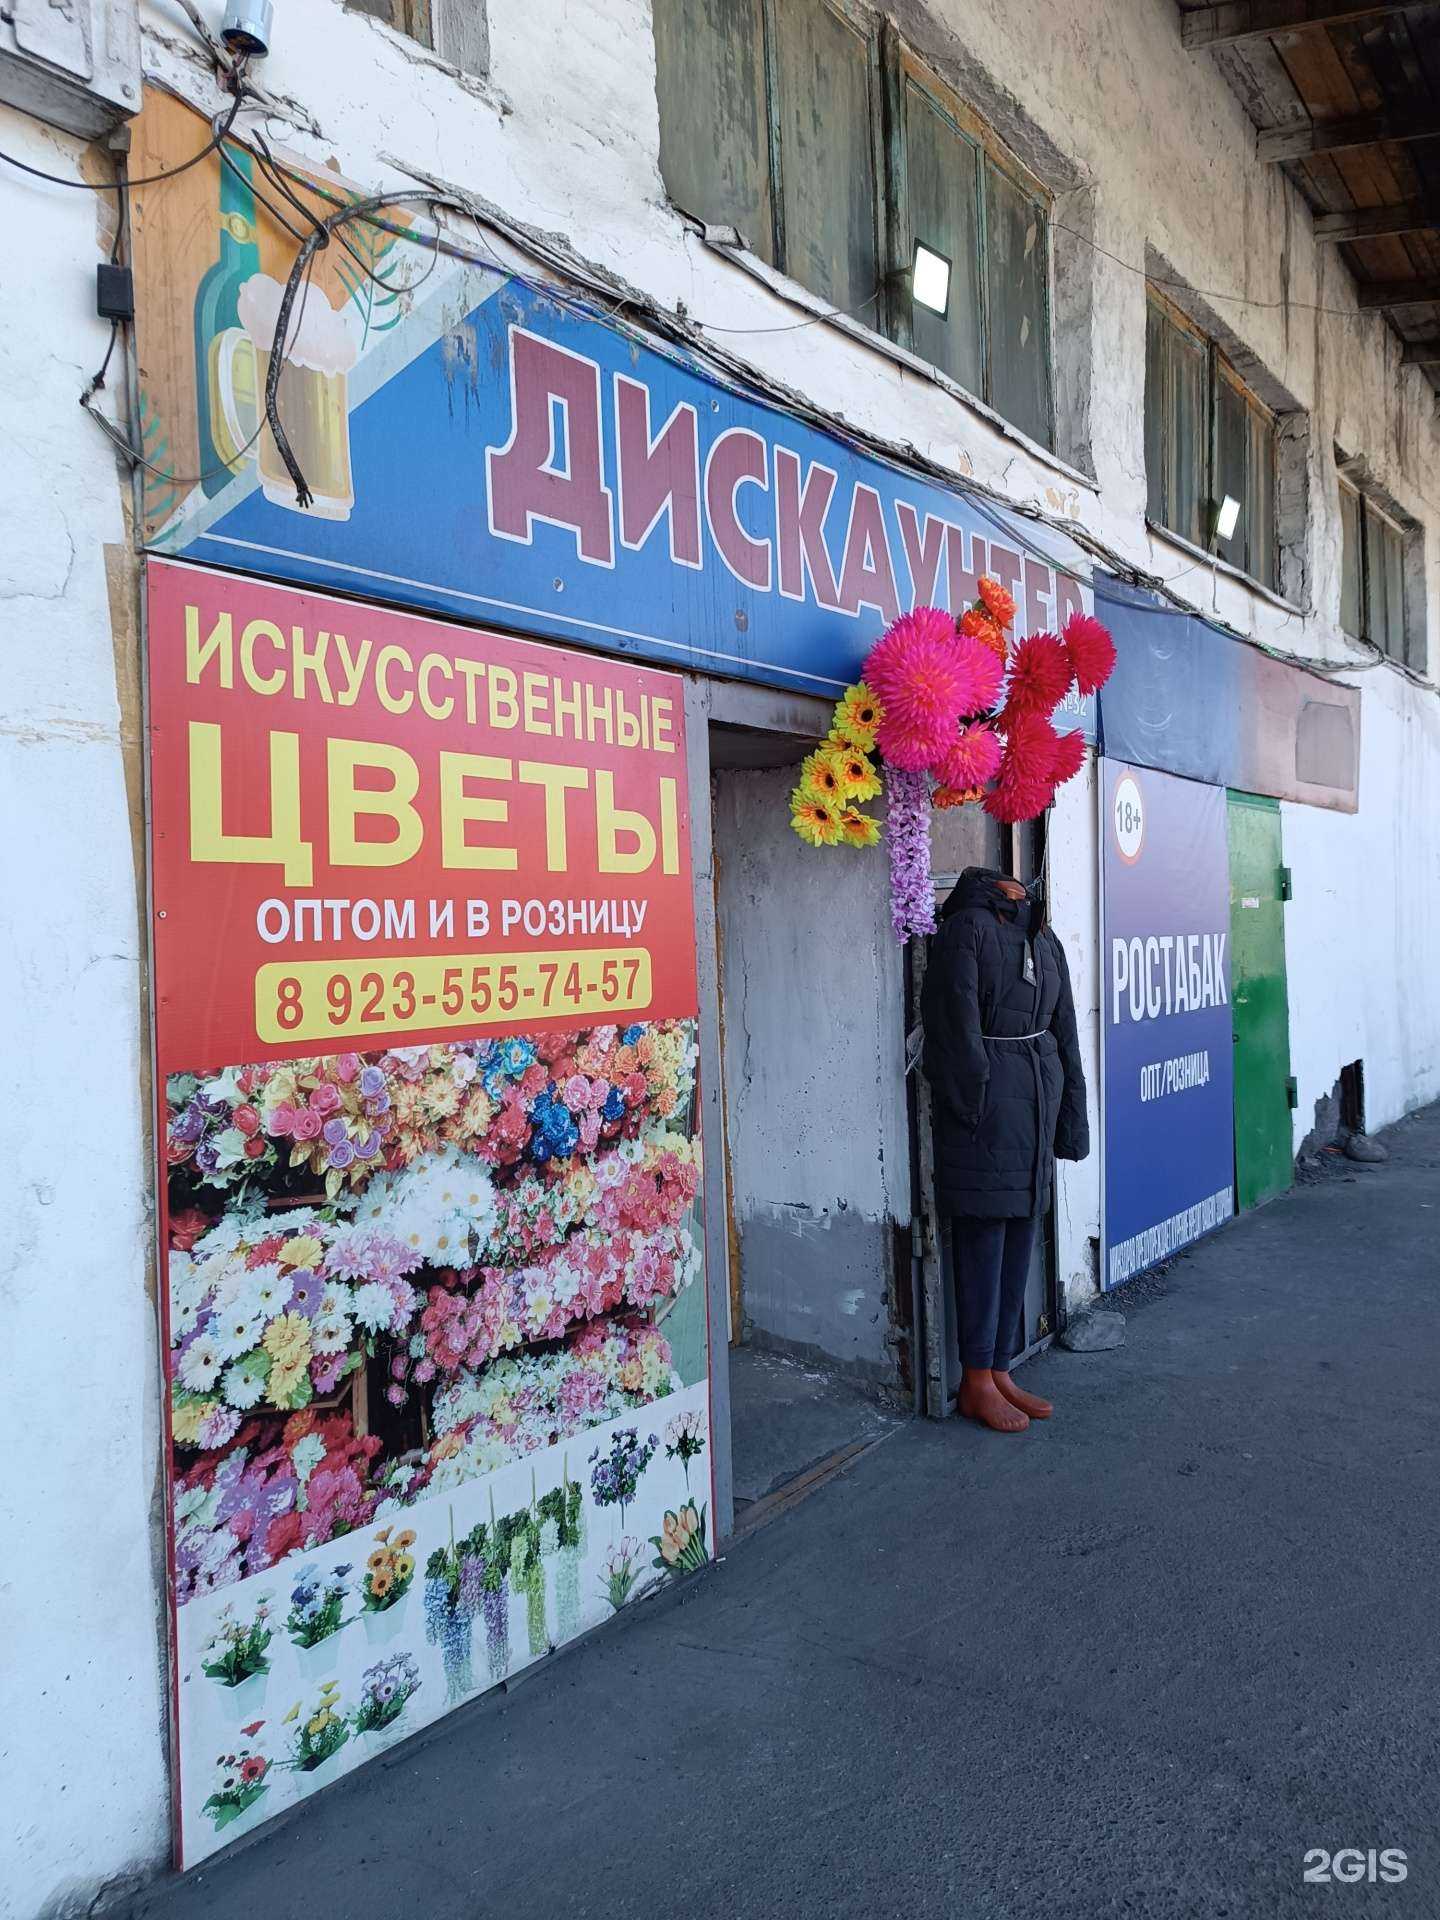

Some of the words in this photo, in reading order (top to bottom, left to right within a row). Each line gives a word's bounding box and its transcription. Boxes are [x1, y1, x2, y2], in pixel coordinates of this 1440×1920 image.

[184, 605, 677, 754] ИСКУССТВЕННЫЕ
[188, 720, 680, 888] ЦВЕТЫ
[1117, 801, 1141, 834] 18+
[256, 898, 416, 944] ОПТОМ
[429, 899, 454, 938] И
[467, 899, 490, 938] В
[502, 899, 648, 939] РОЗНИЦУ
[276, 977, 304, 1030] 8
[326, 958, 640, 1026] 923-555-74-57
[1112, 933, 1228, 1025] РОСТАБАК
[1140, 1050, 1210, 1102] ОПТ/РОЗНИЦА
